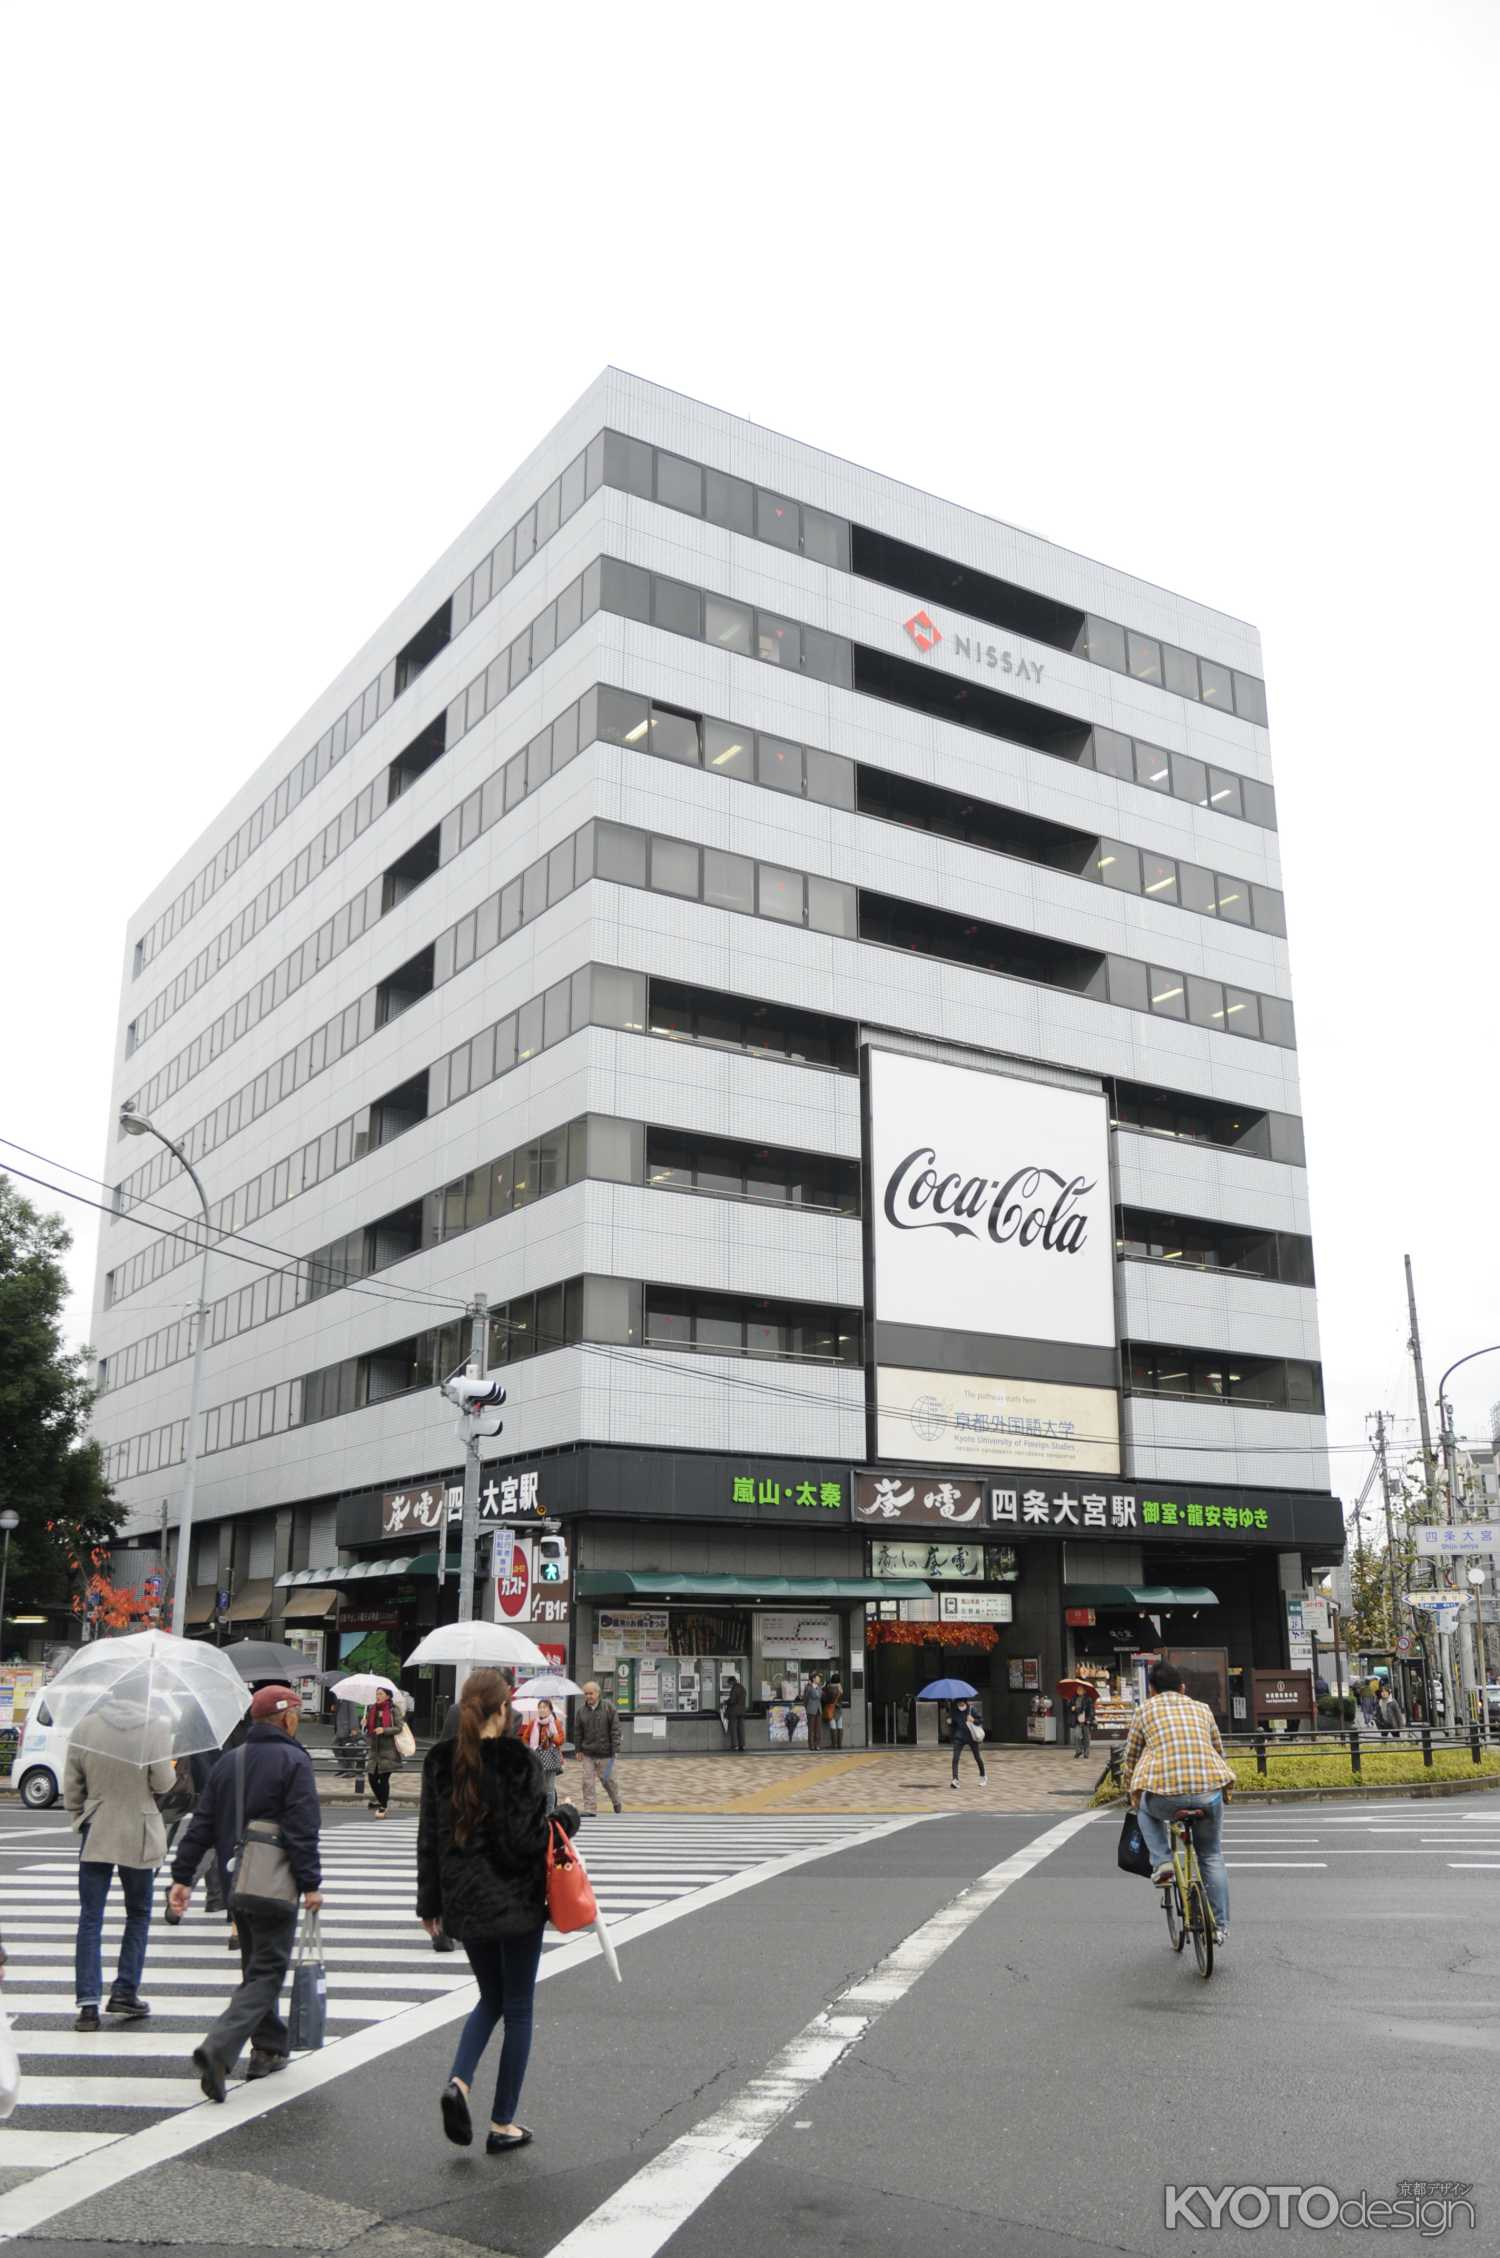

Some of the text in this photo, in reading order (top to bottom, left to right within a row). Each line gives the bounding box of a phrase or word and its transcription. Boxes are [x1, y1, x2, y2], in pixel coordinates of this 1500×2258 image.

[955, 634, 1045, 684] NISSAY
[955, 1411, 1075, 1439] 京都外国語大学
[954, 1434, 1075, 1451] Kyoto University of Foreign Studies
[448, 1472, 539, 1522] 四大宮駅
[733, 1477, 841, 1508] 嵐山・太秦
[858, 1478, 981, 1522] 嵐電
[991, 1488, 1137, 1528] 四条大宮駅
[1142, 1501, 1269, 1529] 御室・龍安寺ゆき
[1426, 1530, 1492, 1542] 四条大宮
[545, 1600, 568, 1621] B1F
